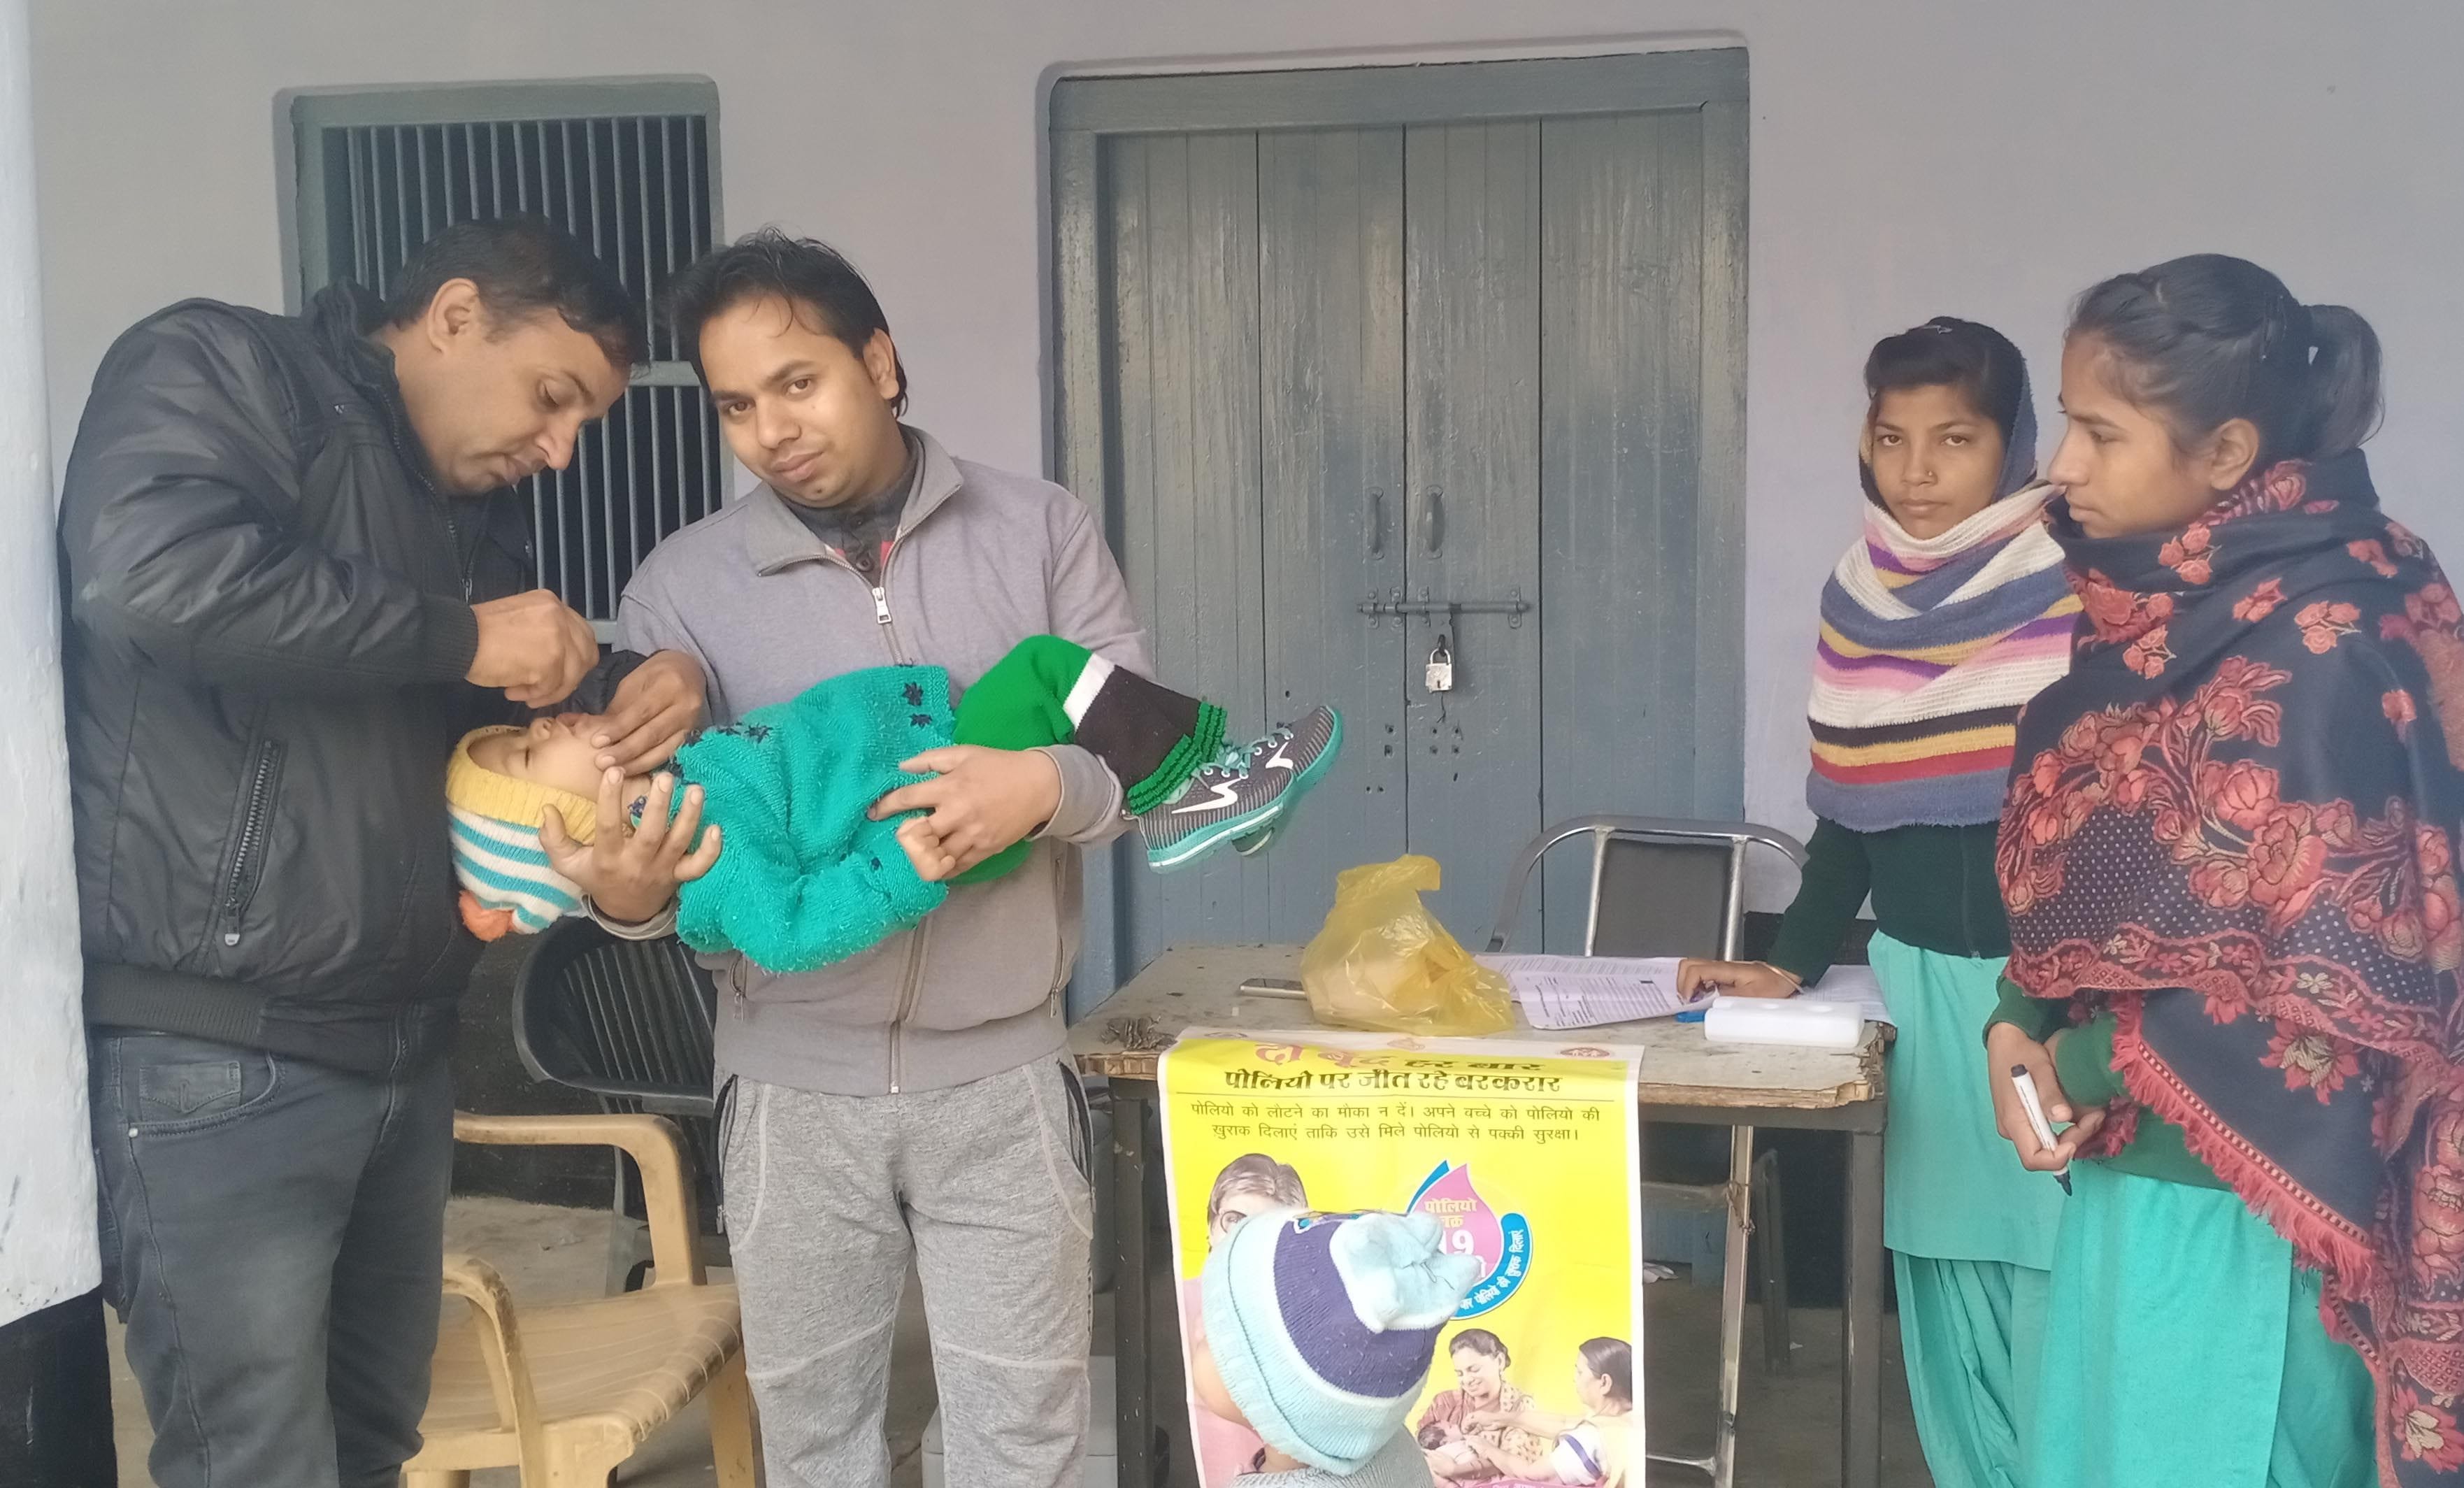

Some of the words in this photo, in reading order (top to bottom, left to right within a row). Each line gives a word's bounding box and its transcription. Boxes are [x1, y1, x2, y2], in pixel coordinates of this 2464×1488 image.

[1224, 1068, 1314, 1089] पोलियो
[1319, 1072, 1353, 1089] पर
[1357, 1068, 1412, 1089] जीत
[1417, 1070, 1453, 1091] रहे
[1454, 1073, 1563, 1092] बरकरार
[1191, 1100, 1234, 1117] पोलियो
[1241, 1102, 1259, 1117] को
[1266, 1103, 1303, 1118] लौटने
[1311, 1106, 1328, 1118] का
[1337, 1103, 1370, 1118] मौका
[1377, 1106, 1389, 1117] न
[1422, 1103, 1455, 1118] अपने
[1500, 1105, 1518, 1120] को
[1526, 1106, 1573, 1121] पोलियो
[1581, 1107, 1600, 1122] की
[1258, 1122, 1298, 1140] दिलाएं
[1305, 1123, 1338, 1139] ताकि
[1346, 1124, 1370, 1138] उसे
[1379, 1122, 1405, 1138] मिले
[1413, 1123, 1459, 1138] पोलियो
[1468, 1124, 1481, 1140] से
[1488, 1125, 1525, 1140] पक्की
[1424, 1197, 1477, 1214] पोलियो
